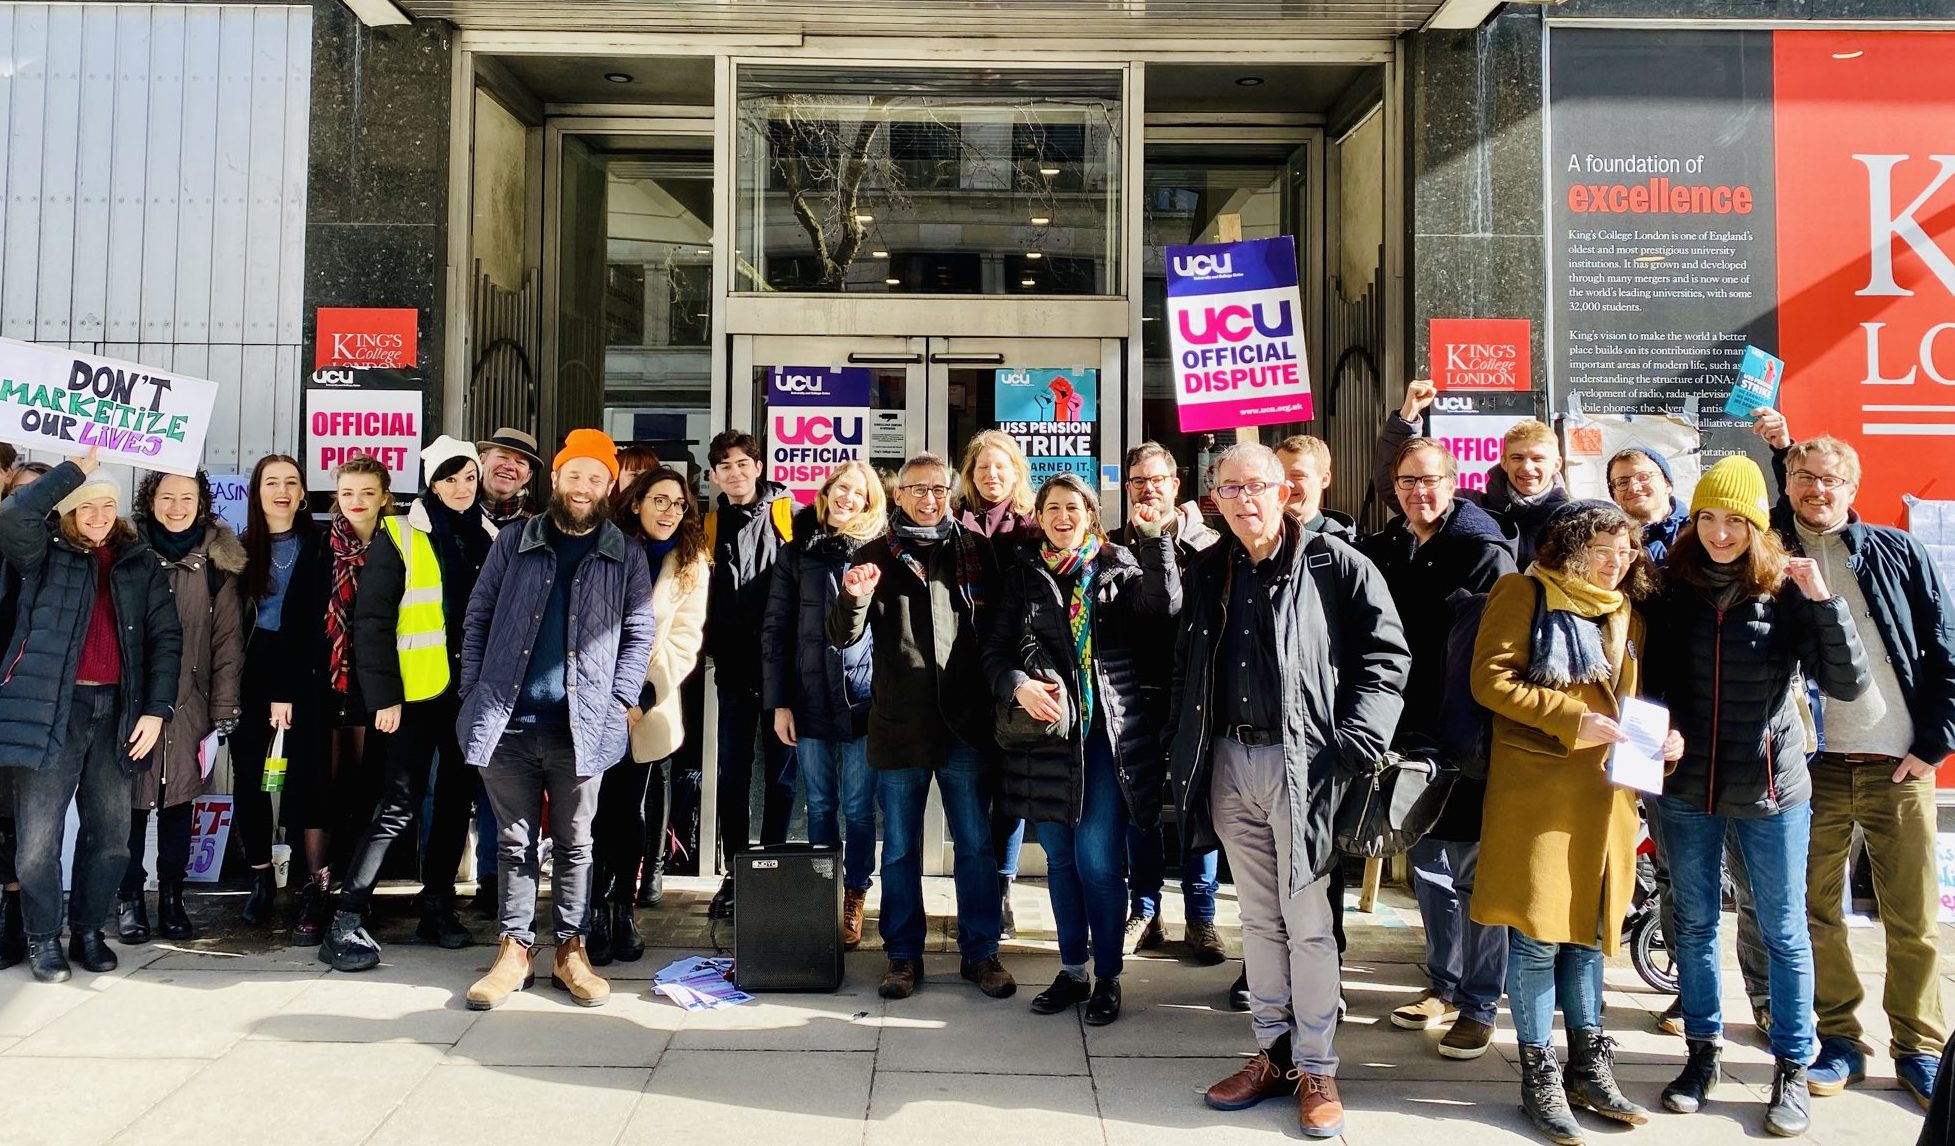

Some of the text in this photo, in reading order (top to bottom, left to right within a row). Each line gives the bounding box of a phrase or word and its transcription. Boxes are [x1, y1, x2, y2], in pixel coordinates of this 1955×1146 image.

[1568, 154, 1704, 173] A foundation of
[1568, 177, 1753, 214] excellence
[1852, 154, 1955, 296] K
[1568, 230, 1596, 242] King's
[1599, 230, 1632, 242] College
[1635, 231, 1669, 240] London
[1671, 231, 1678, 240] is
[1699, 231, 1708, 241] of
[1709, 231, 1753, 243] England's
[1568, 245, 1736, 256] oldest and most prestigious university
[1568, 259, 1747, 270] institutions. It has grown and developed
[1569, 274, 1604, 284] through
[1607, 276, 1632, 285] many
[1634, 276, 1670, 285] mergers
[1672, 274, 1690, 283] and
[1692, 274, 1699, 283] is
[1741, 274, 1751, 284] of
[1569, 288, 1584, 297] the
[1586, 287, 1618, 297] world's
[1619, 288, 1651, 299] leading
[1653, 290, 1705, 298] universities,
[1707, 289, 1727, 298] with
[1569, 302, 1642, 312] 32,000 students.
[1570, 331, 1598, 342] King's
[1600, 332, 1626, 340] vision
[1640, 332, 1665, 340] make
[1667, 332, 1682, 341] the
[1684, 332, 1710, 341] world
[1719, 332, 1747, 341] better
[356, 348, 402, 364] College
[1182, 342, 1296, 369] OFFICIAL
[1570, 346, 1593, 356] place
[1595, 345, 1622, 355] builds
[1638, 346, 1648, 355] its
[1650, 346, 1710, 355] contributions
[1859, 322, 1955, 386] LO
[1470, 358, 1516, 374] College
[1570, 360, 1615, 370] important
[1643, 360, 1652, 369] of
[1653, 360, 1688, 369] modern
[1690, 360, 1708, 371] life,
[1709, 361, 1731, 370] such
[1184, 363, 1300, 394] DISPUTE
[1446, 372, 1516, 385] LONDON
[1570, 375, 1634, 385] understanding
[1636, 375, 1650, 384] the
[1695, 374, 1704, 384] of
[1706, 375, 1734, 385] DNA;
[68, 360, 172, 412] DON'T
[1628, 389, 1638, 398] of
[1640, 389, 1664, 399] radio,
[1693, 389, 1731, 398] televisio
[1580, 402, 1601, 411] obile
[1603, 403, 1638, 413] phones;
[1640, 403, 1656, 412] the
[1700, 404, 1723, 412] antis
[21, 409, 77, 441] OUR
[312, 412, 417, 436] OFFICIAL
[1000, 422, 1091, 434] USS PENSION
[1699, 418, 1733, 428] alliative
[1014, 435, 1091, 456] TRIKE
[774, 448, 859, 462] OFFICIAL
[1030, 462, 1090, 472] ARNED IT.
